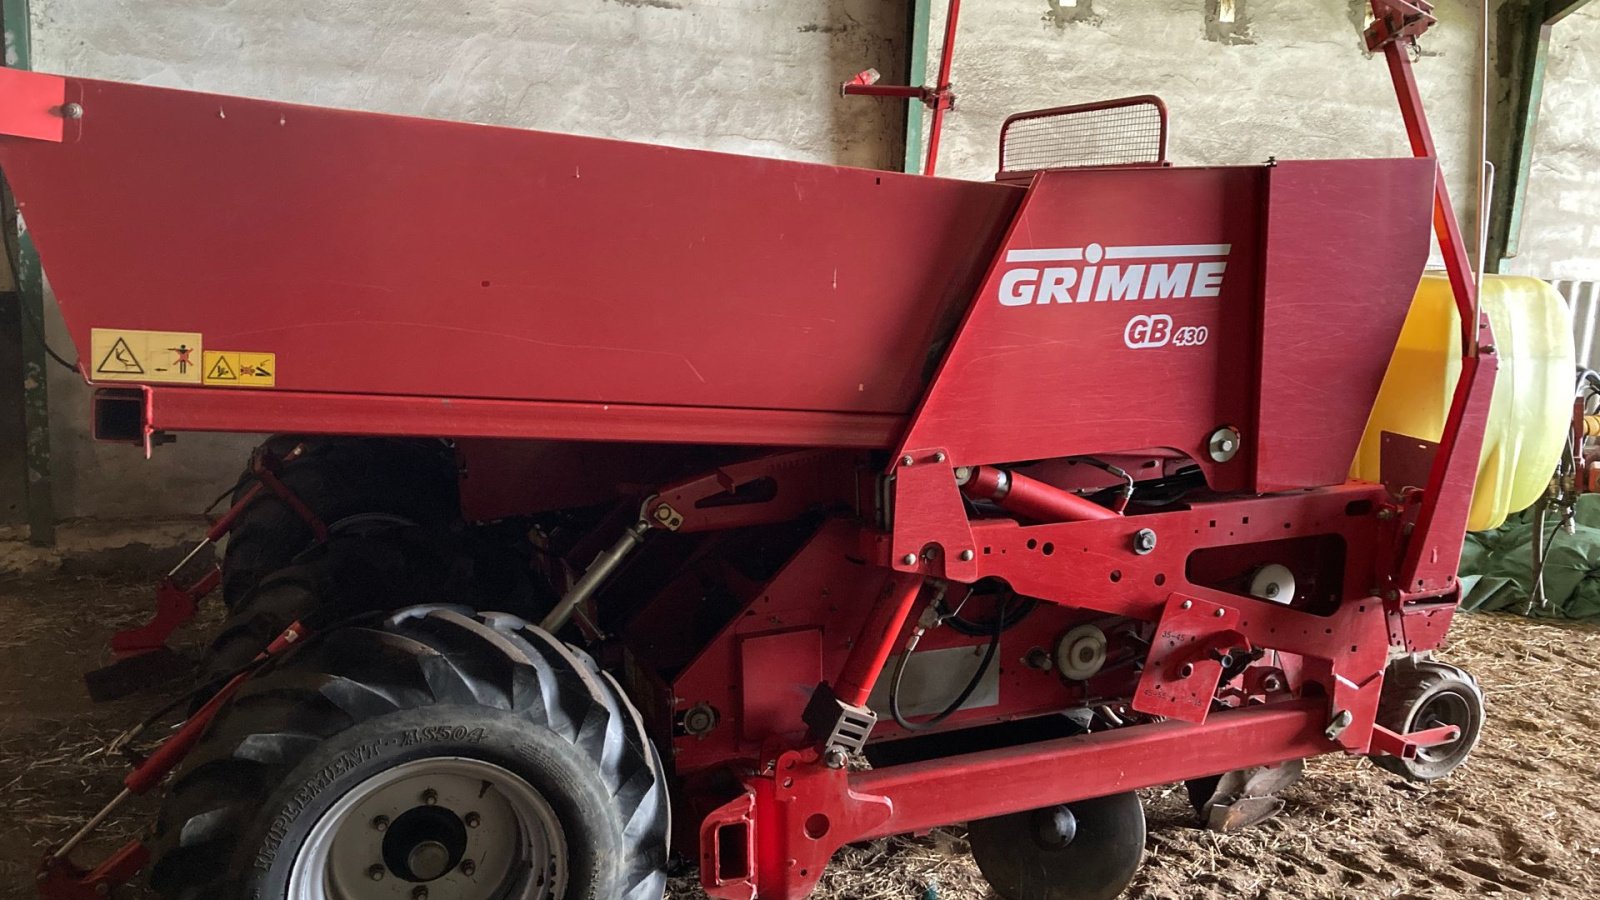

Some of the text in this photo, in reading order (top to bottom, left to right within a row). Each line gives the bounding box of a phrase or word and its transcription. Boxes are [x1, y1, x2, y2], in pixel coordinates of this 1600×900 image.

[998, 243, 1228, 307] GRIMME
[1124, 314, 1208, 349] GB 430
[1161, 630, 1185, 641] 35-45
[254, 725, 488, 872] IMPLEMENT AS504
